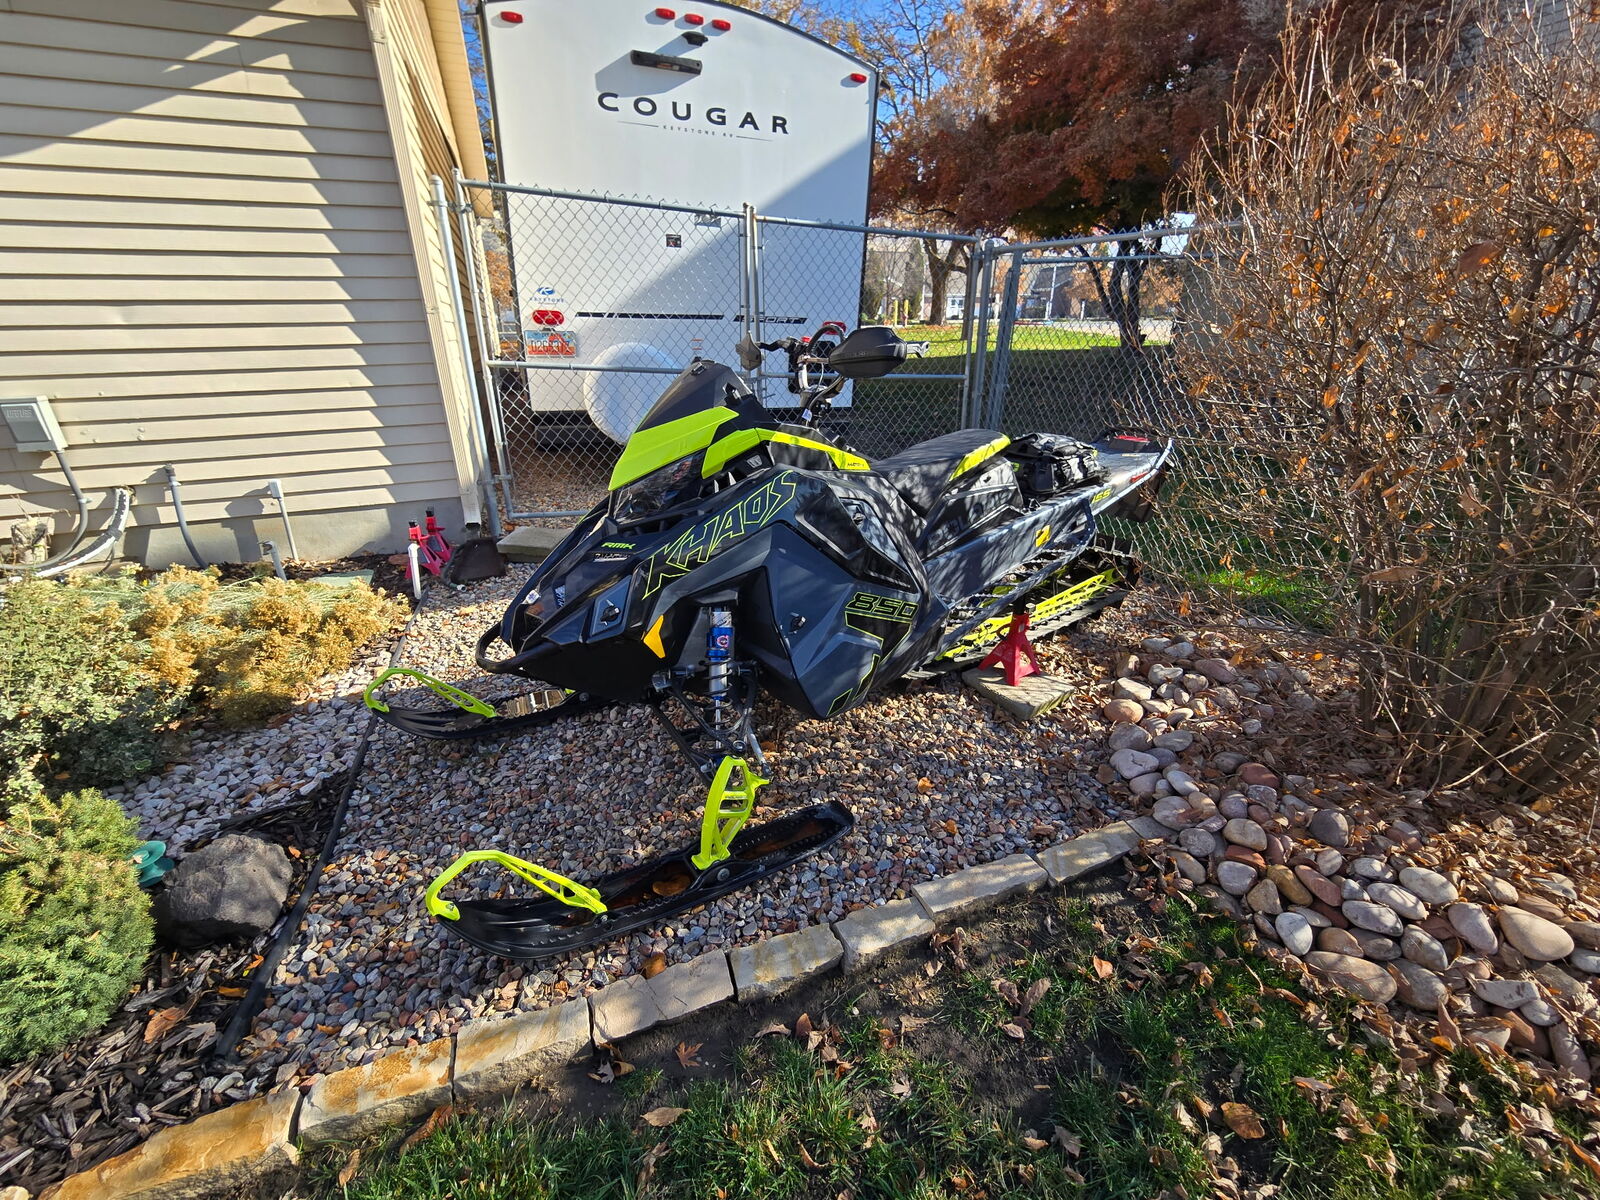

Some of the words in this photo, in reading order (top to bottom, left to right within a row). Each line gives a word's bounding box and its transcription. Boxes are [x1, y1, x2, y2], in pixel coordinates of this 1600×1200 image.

[597, 92, 789, 135] COUGAR
[601, 541, 636, 549] RMK
[642, 470, 796, 600] KHAOS
[845, 592, 919, 619] 850
